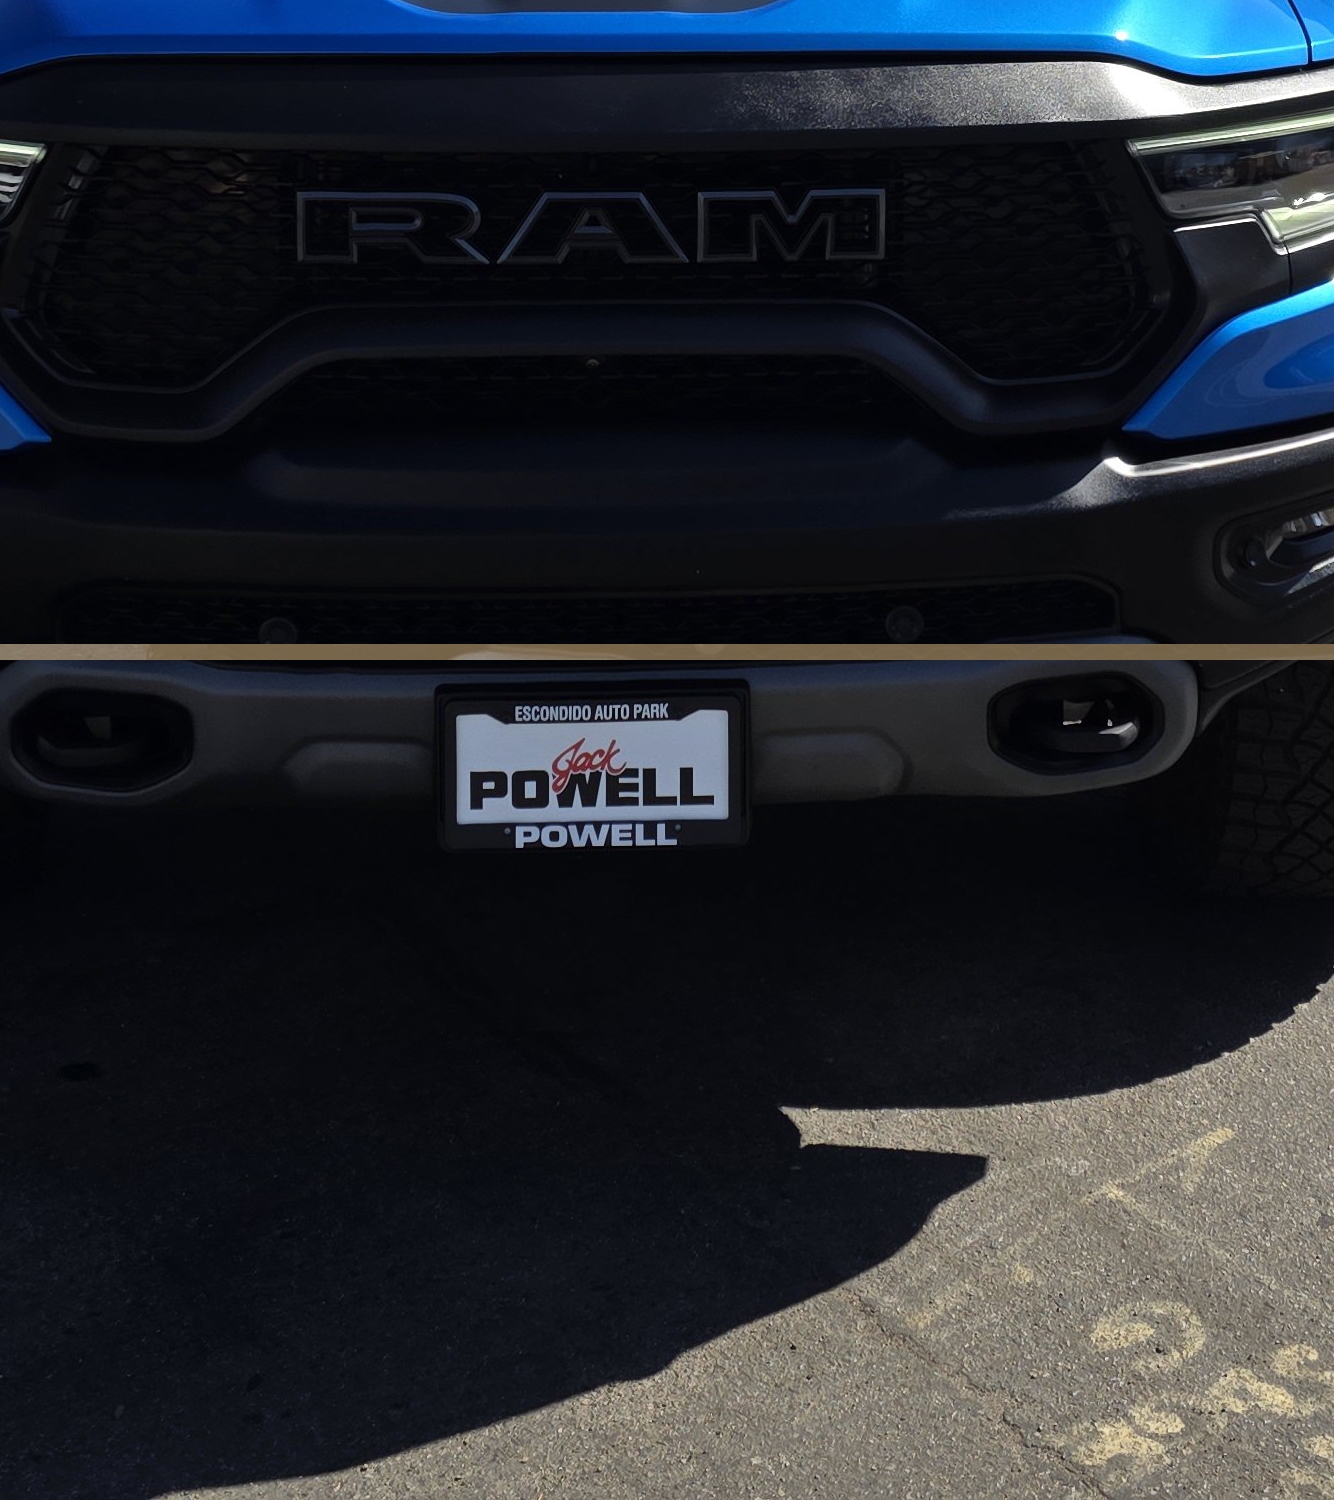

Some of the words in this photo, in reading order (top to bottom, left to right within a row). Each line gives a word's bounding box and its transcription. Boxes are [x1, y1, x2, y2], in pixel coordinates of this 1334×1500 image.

[296, 188, 886, 264] RAM
[514, 704, 592, 722] ESCONDIDO
[594, 703, 630, 721] AUTO
[633, 703, 670, 719] PARK
[551, 737, 627, 794] Jack
[469, 767, 715, 810] POWELL
[515, 823, 678, 848] POWELL
